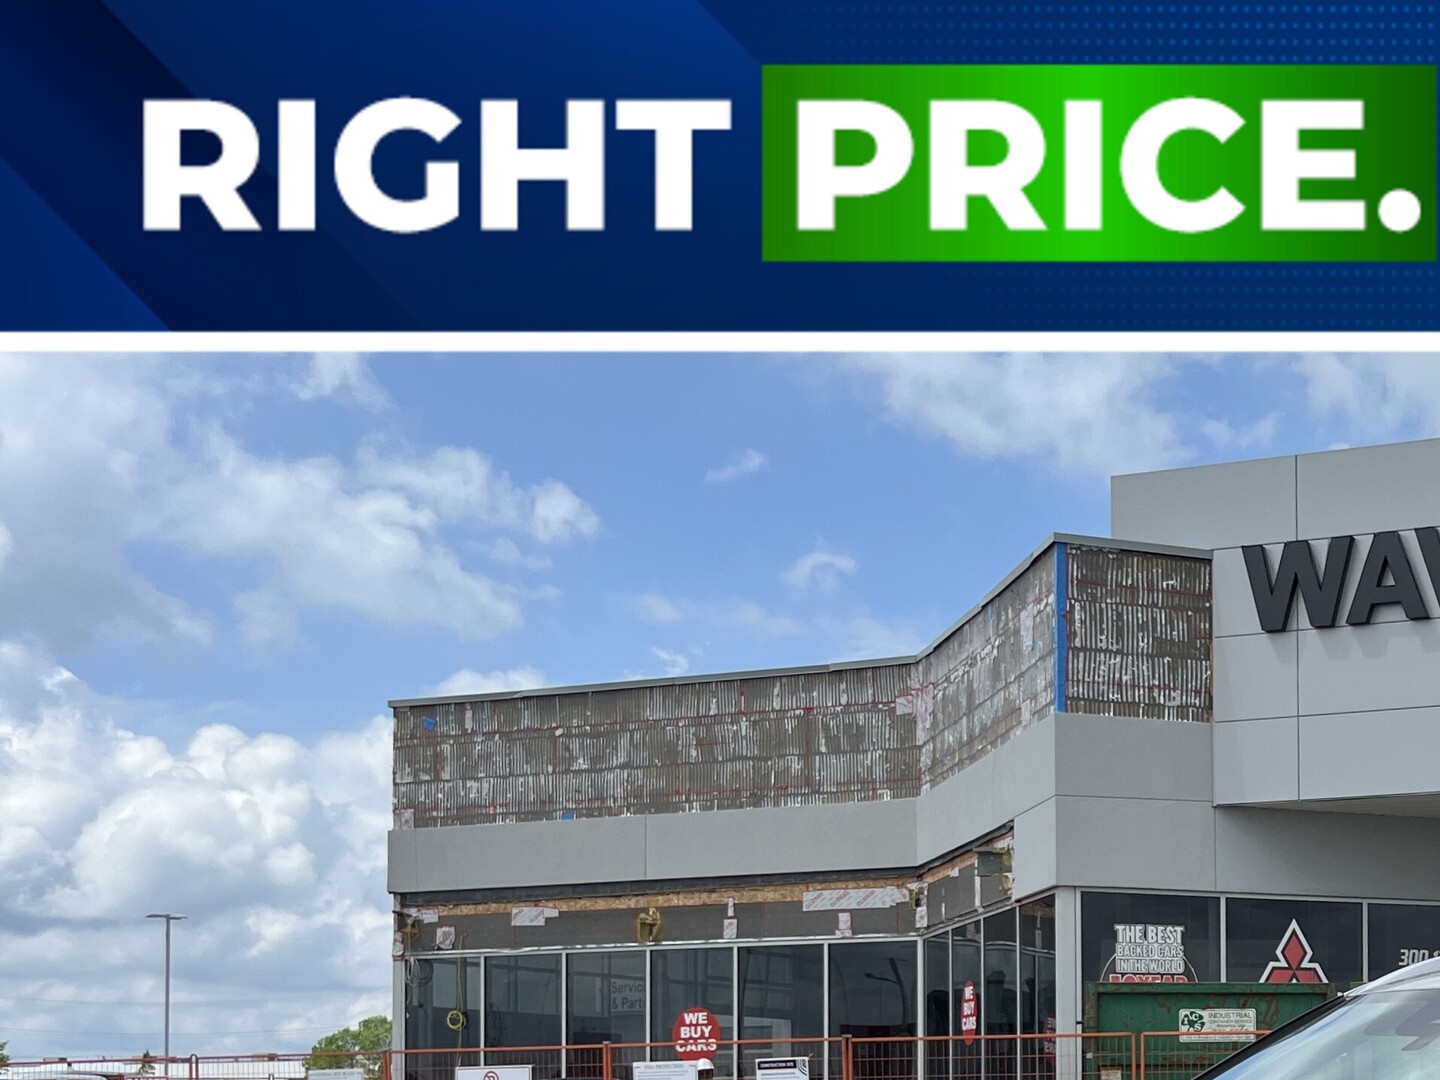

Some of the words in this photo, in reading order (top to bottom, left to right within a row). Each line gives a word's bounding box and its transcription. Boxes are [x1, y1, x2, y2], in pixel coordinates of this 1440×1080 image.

[1114, 924, 1144, 943] THE
[1147, 925, 1184, 944] BEST
[1116, 944, 1156, 958] BACKED
[1157, 944, 1184, 958] CARS
[1116, 959, 1127, 972] IN
[1128, 959, 1148, 972] THE
[1149, 959, 1185, 973] WORLD
[612, 981, 645, 993] Servic
[621, 997, 645, 1009] Part
[683, 1012, 708, 1025] WE
[680, 1025, 713, 1039] BUY
[675, 1038, 717, 1052] CARS
